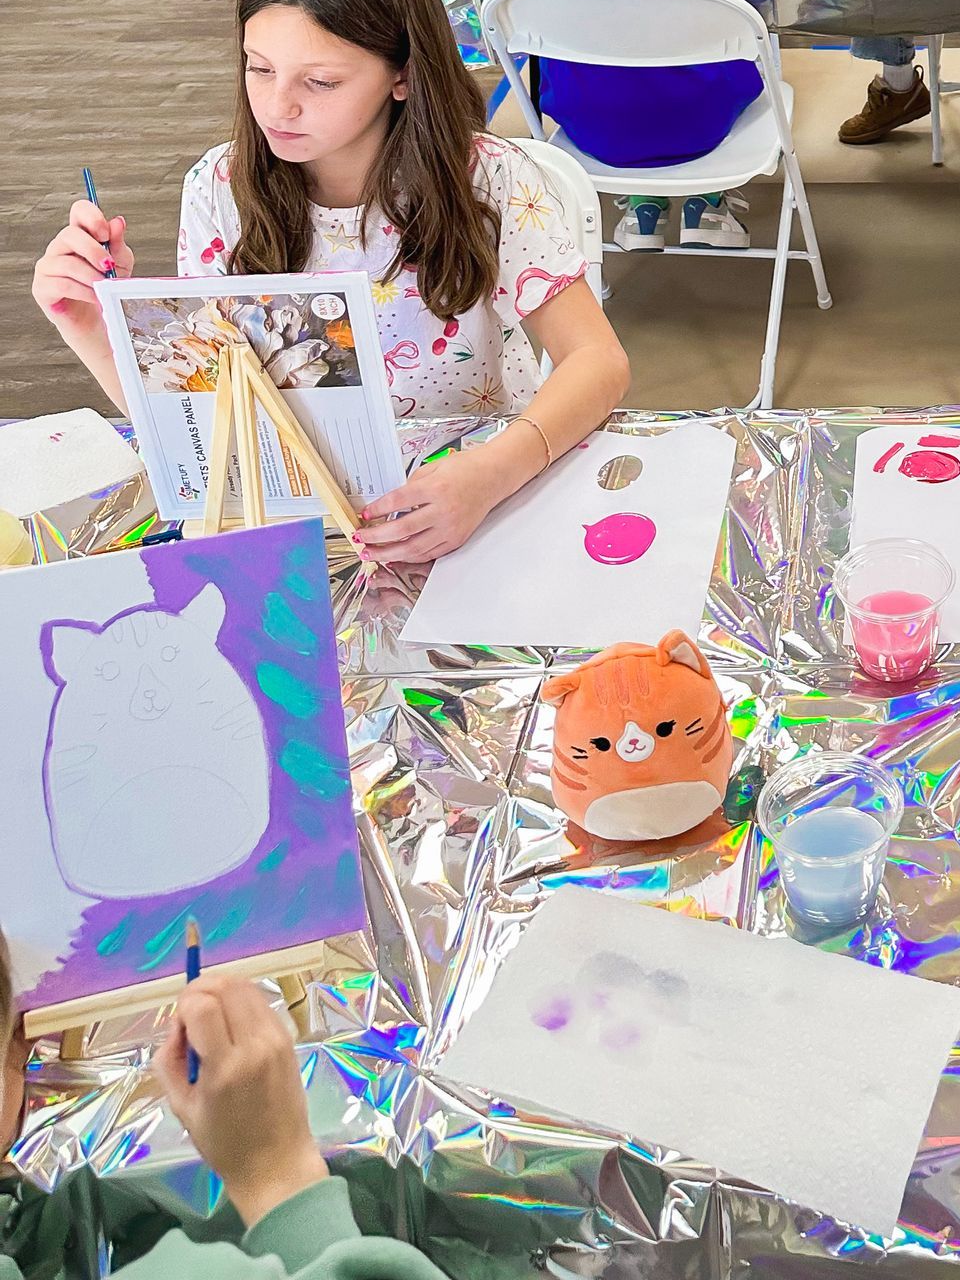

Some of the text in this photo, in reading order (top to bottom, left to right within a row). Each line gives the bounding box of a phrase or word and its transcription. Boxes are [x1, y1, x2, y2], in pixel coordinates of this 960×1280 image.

[179, 395, 197, 425] PANEL
[188, 426, 207, 461] CANVAS
[177, 463, 194, 496] SIMETUFY
